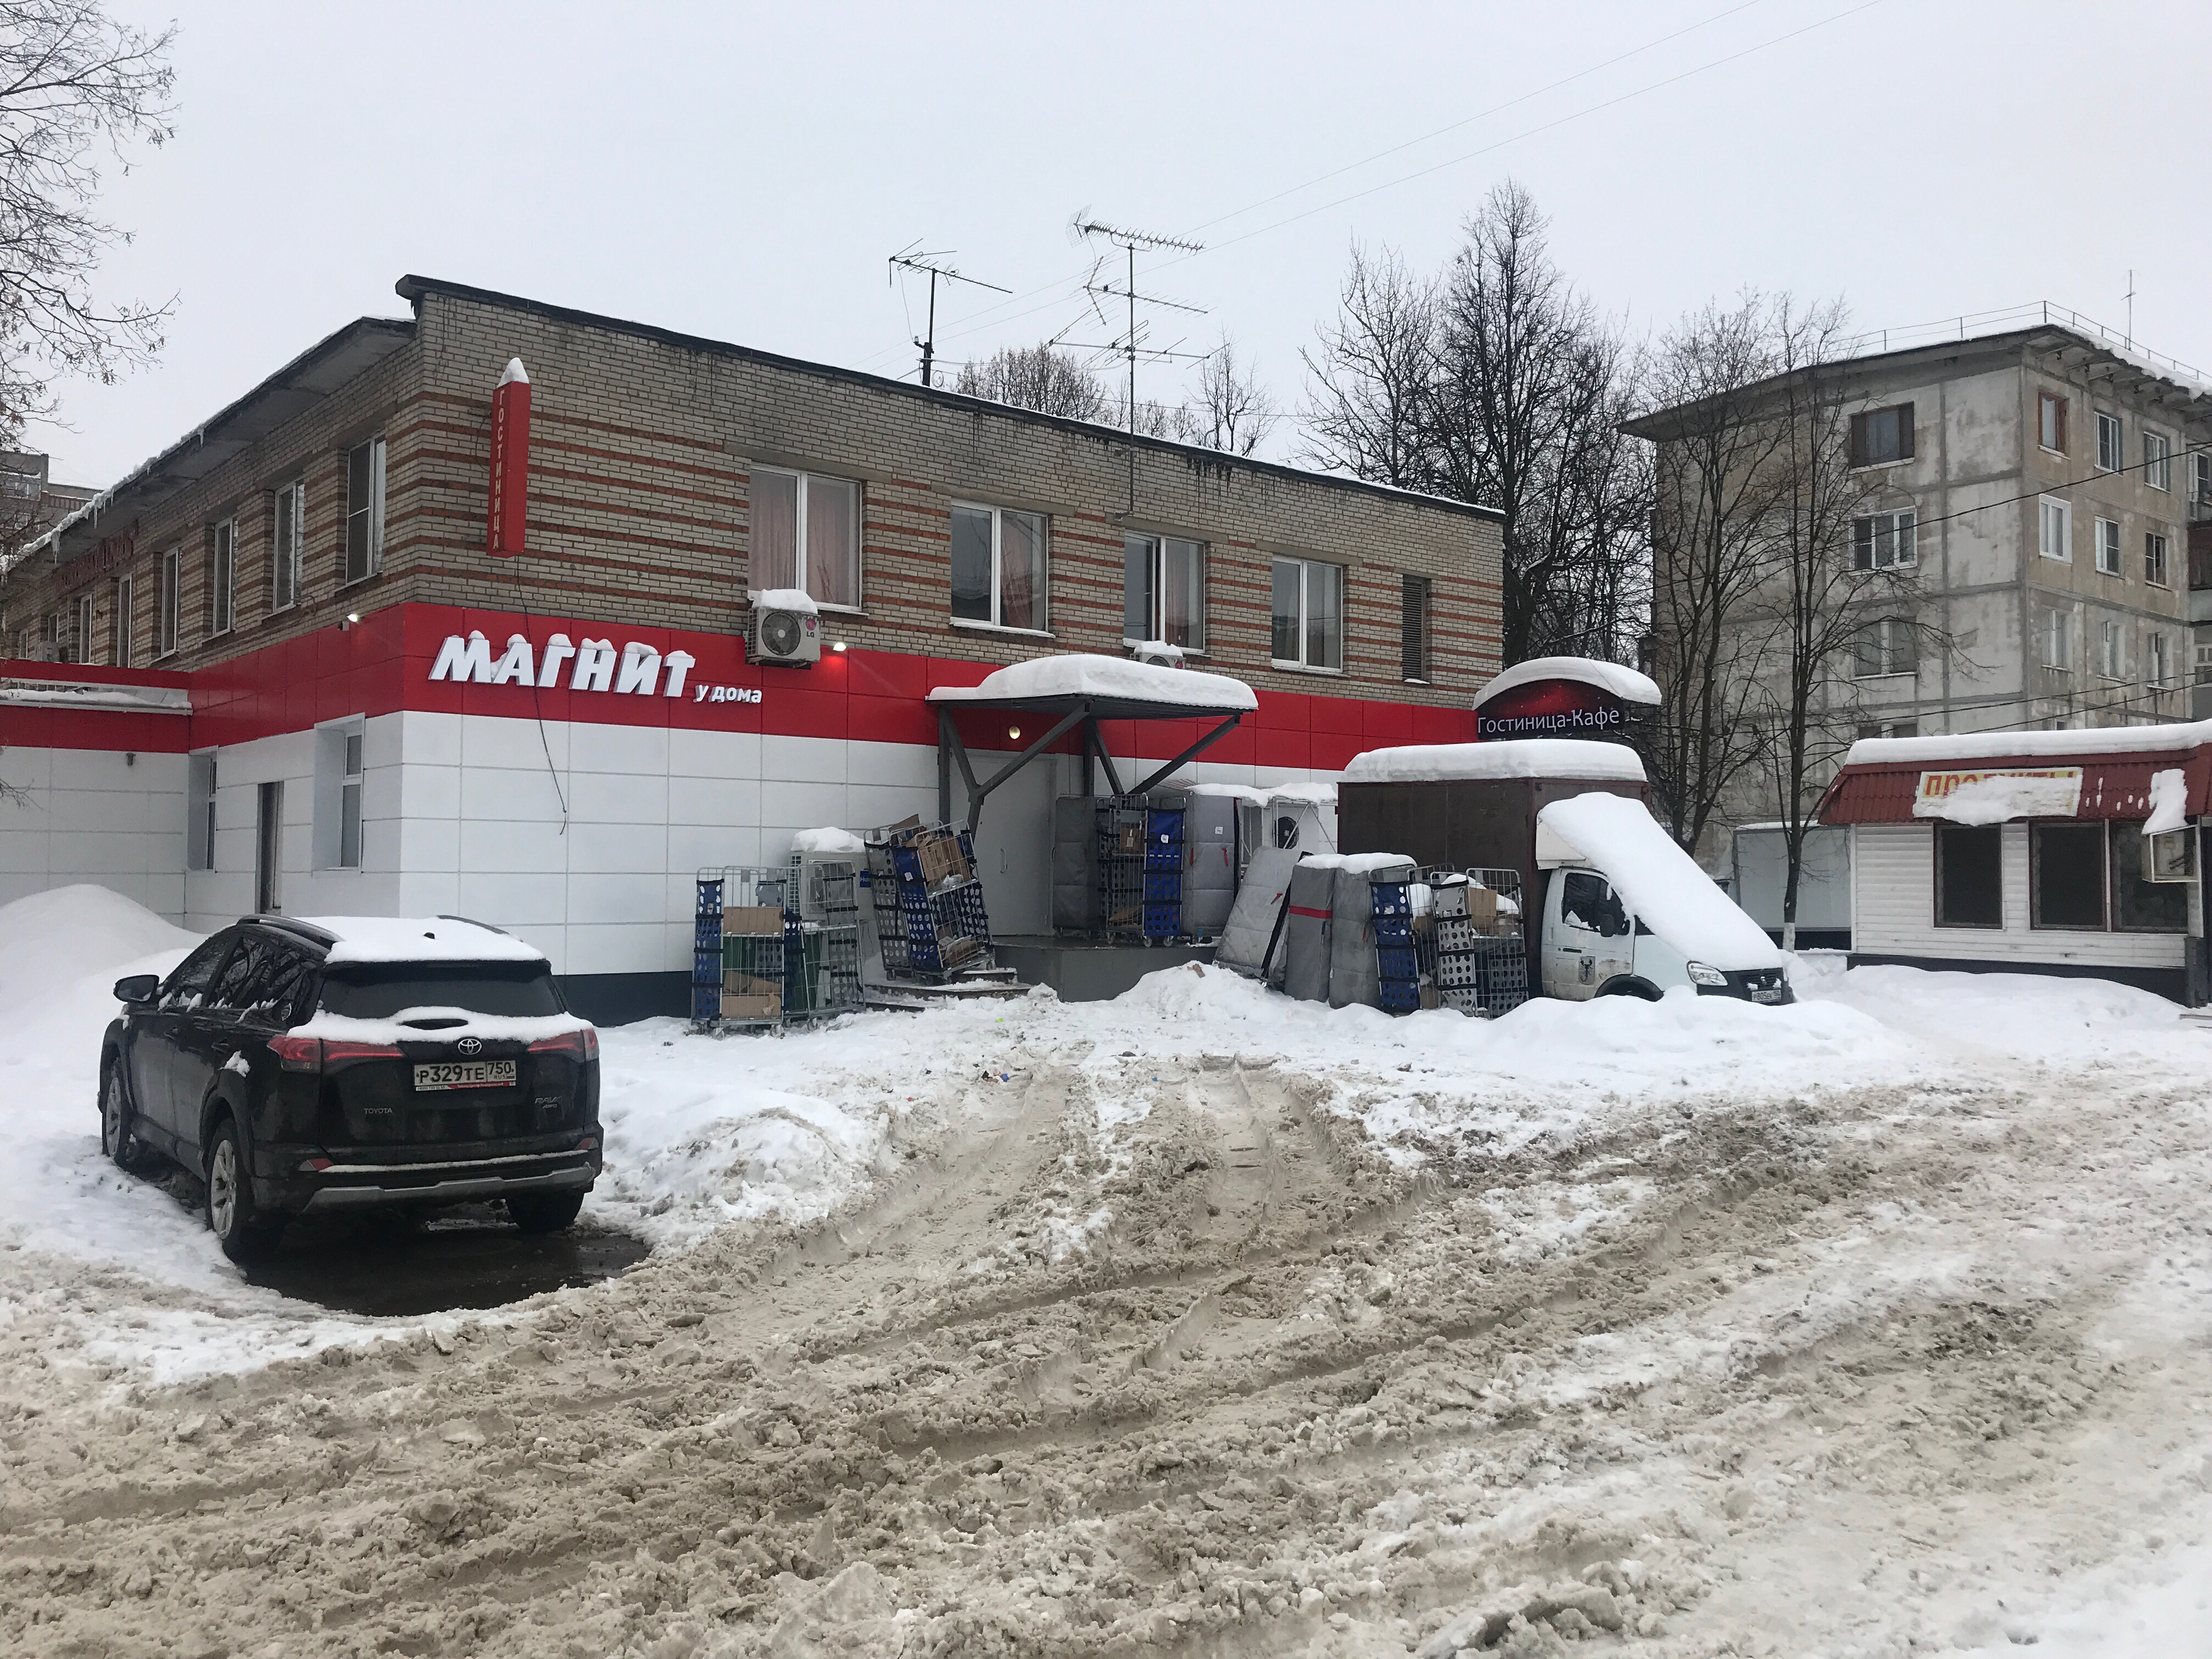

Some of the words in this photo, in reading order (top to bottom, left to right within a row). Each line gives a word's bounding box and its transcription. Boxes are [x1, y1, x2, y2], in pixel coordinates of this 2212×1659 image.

[494, 390, 505, 549] ГОСТИНИЦА
[428, 636, 696, 697] МАГНИТ
[694, 684, 709, 703] у
[709, 686, 762, 703] дома
[1477, 706, 1620, 733] Гостиница-Кафе
[487, 1061, 512, 1075] 750
